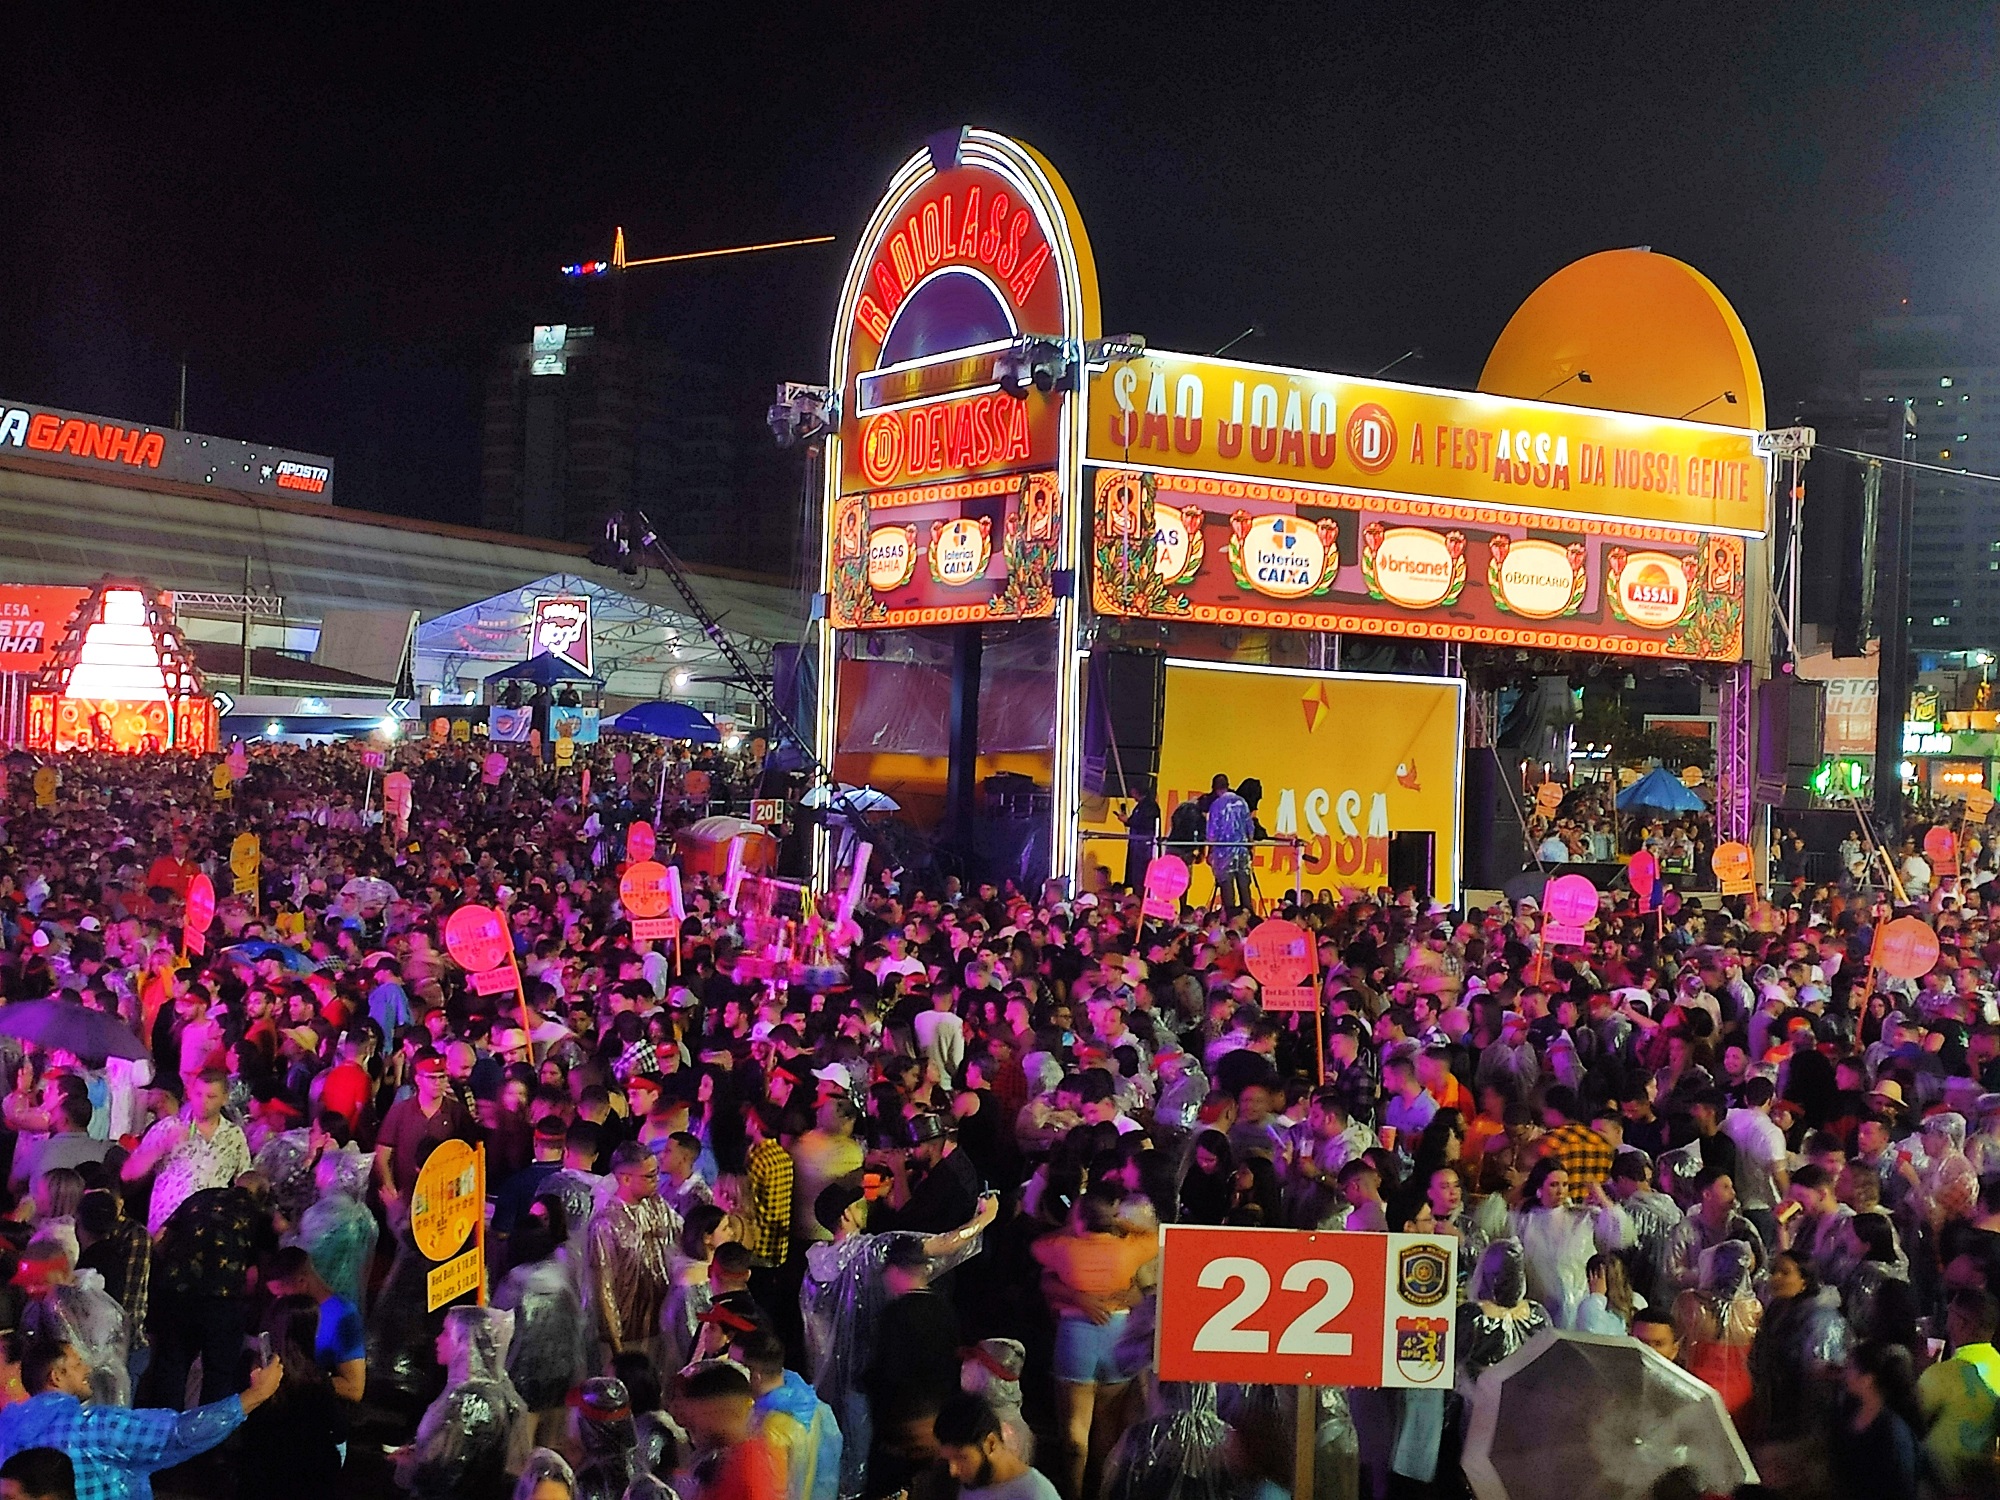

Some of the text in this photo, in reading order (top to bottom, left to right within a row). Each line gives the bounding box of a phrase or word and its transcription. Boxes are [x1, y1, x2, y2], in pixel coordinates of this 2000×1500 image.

[856, 185, 1053, 345] RADIOLASSA
[27, 413, 165, 469] GANHA
[907, 395, 1030, 477] DEVASSA
[1109, 360, 1204, 455] SÃO
[1218, 375, 1337, 469] JOÃO
[1409, 421, 1424, 465] A
[1579, 442, 1605, 487] DA
[1613, 447, 1681, 496] NOSSA
[1687, 455, 1750, 503] GENTE
[276, 461, 329, 482] APOSTA
[278, 473, 325, 493] GANHA
[871, 544, 904, 560] CASAS
[944, 547, 974, 561] loterias
[1258, 550, 1310, 567] loterias
[870, 559, 901, 574] BAHIA
[944, 560, 973, 574] CAIXA
[1389, 554, 1449, 577] brisanet
[1258, 567, 1310, 585] CAIXA
[756, 804, 774, 821] 20
[1192, 1256, 1354, 1356] 22
